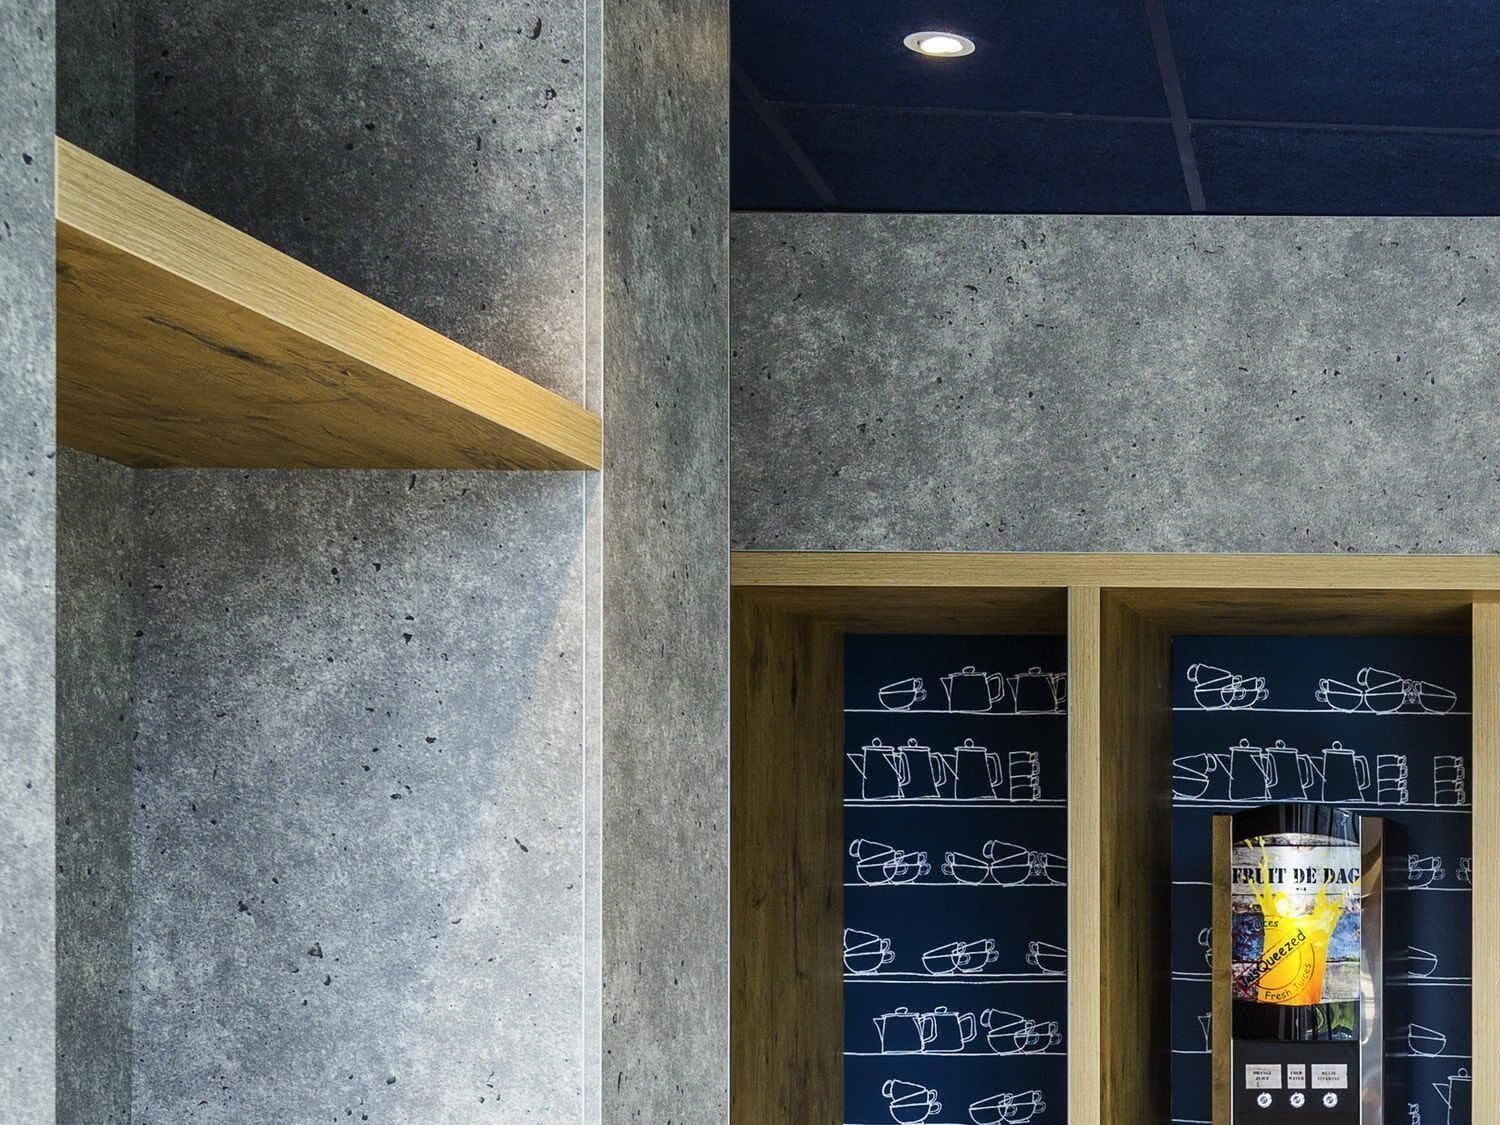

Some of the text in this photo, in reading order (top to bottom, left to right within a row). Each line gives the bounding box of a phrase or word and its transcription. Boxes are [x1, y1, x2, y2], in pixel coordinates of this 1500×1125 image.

[1232, 867, 1360, 884] FRUIT DE DAG
[1264, 988, 1293, 1000] Fresh
